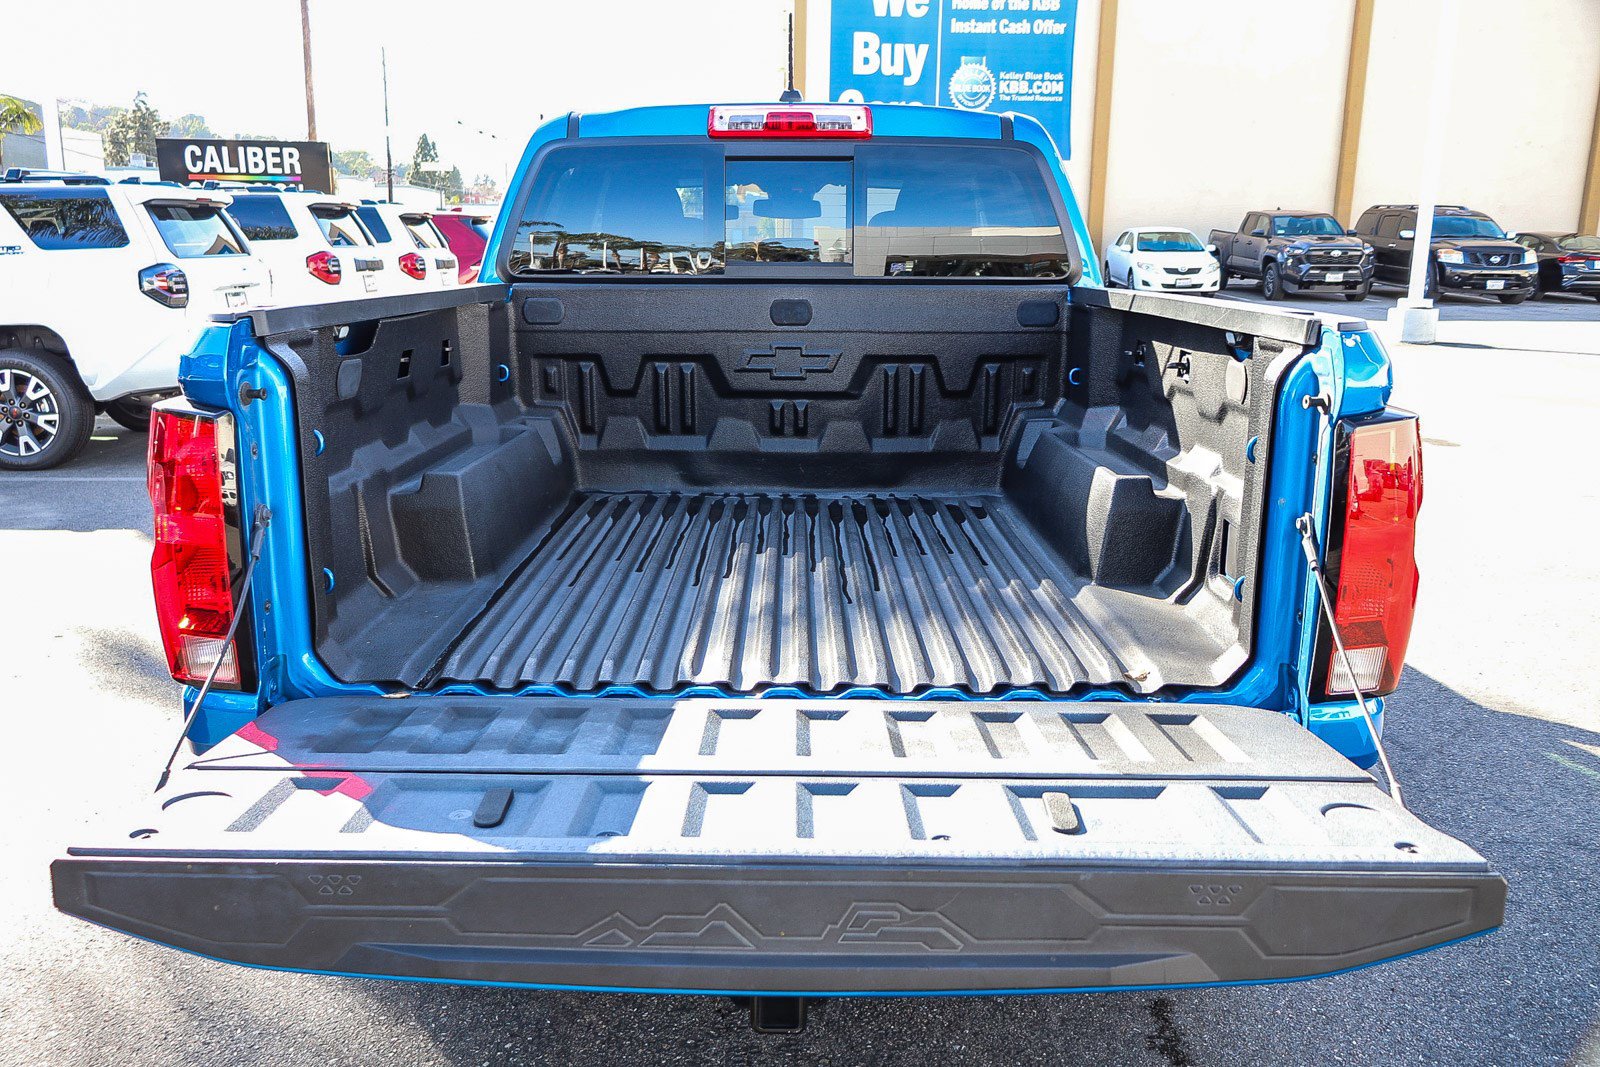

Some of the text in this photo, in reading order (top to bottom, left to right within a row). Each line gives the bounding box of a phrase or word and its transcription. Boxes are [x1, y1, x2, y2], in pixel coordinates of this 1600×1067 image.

[951, 0, 1061, 11] Home of the KBB
[950, 18, 1067, 34] Instant Cash Offer
[852, 31, 930, 87] Buy
[999, 71, 1024, 81] Kelley
[1025, 71, 1043, 80] Blue
[1044, 72, 1064, 80] Book
[999, 80, 1064, 94] KBB.COM
[184, 144, 302, 175] CALIBER
